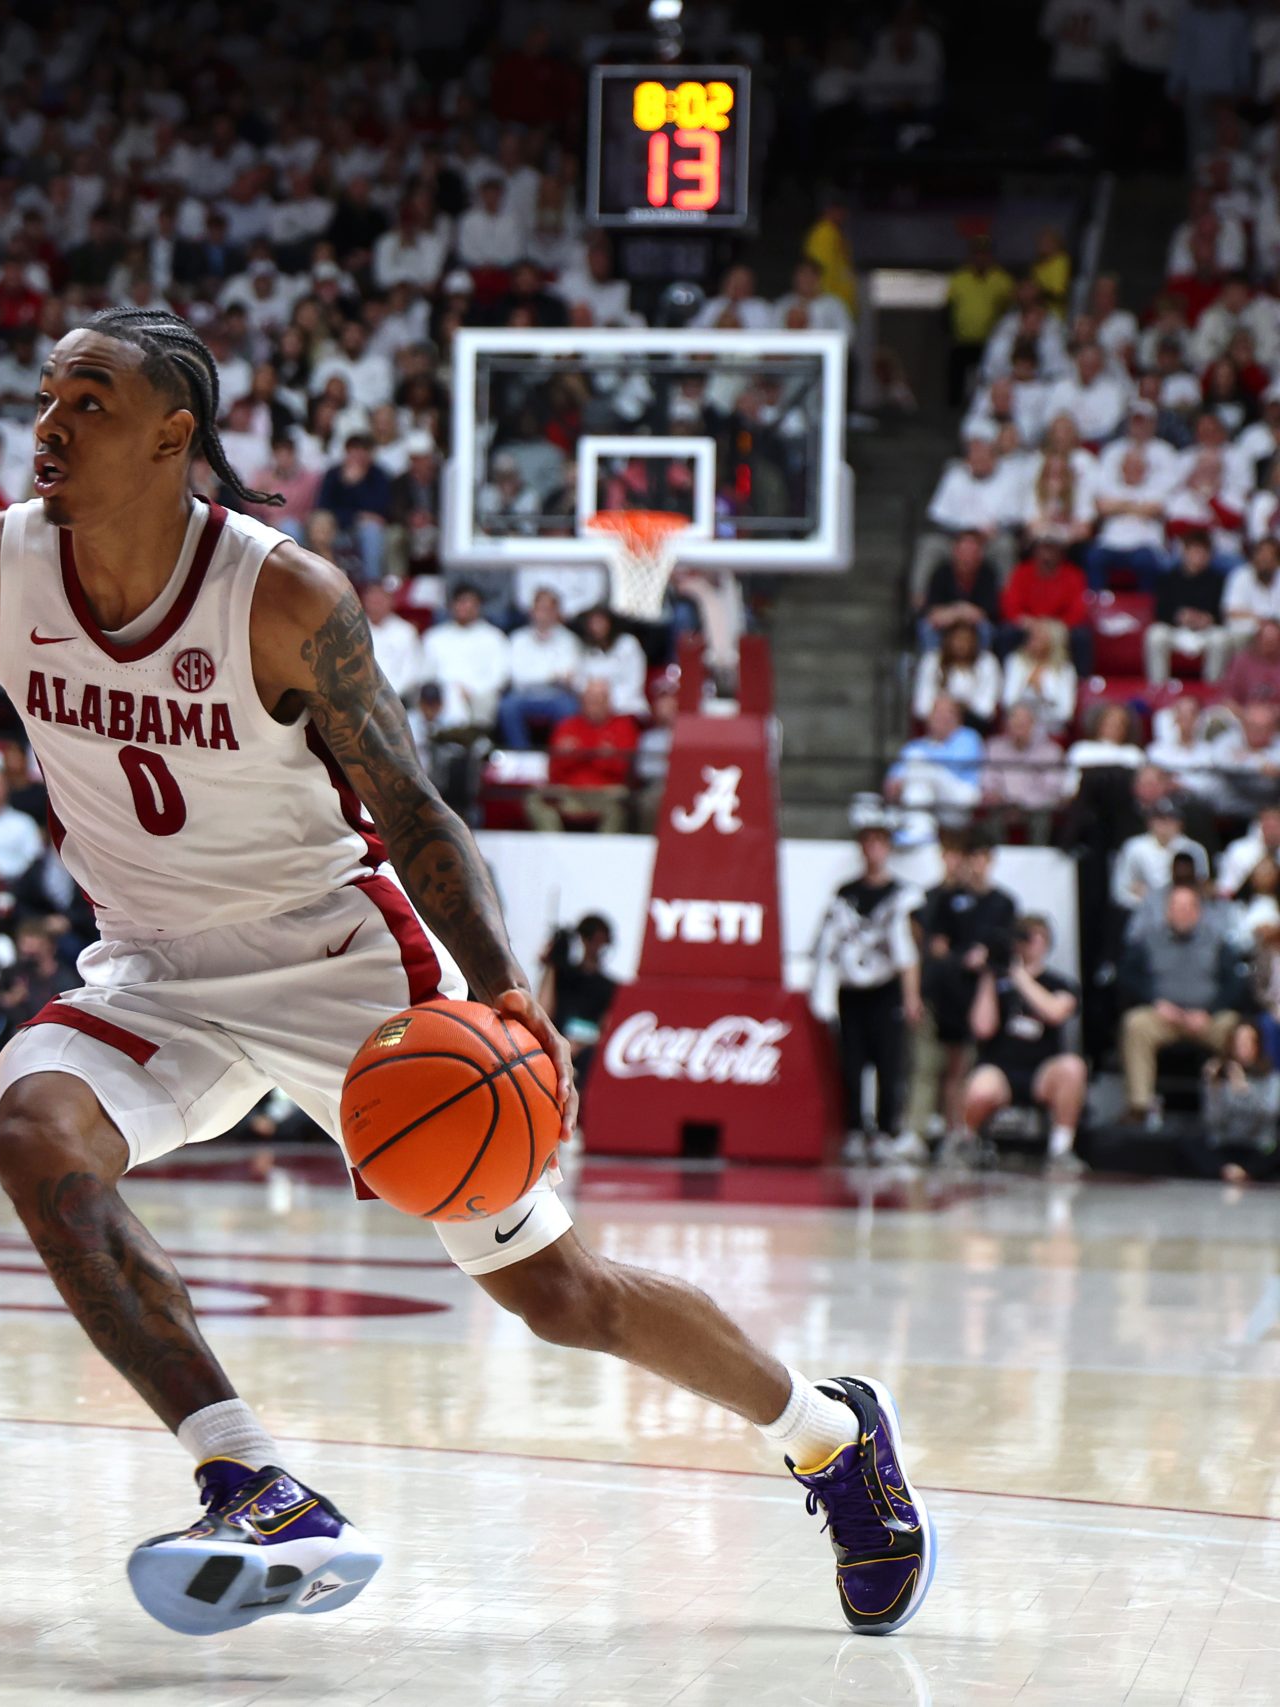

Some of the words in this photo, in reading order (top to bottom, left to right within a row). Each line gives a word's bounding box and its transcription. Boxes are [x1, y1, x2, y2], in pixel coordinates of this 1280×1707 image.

[633, 81, 734, 131] 8:02
[647, 129, 720, 211] 13
[174, 651, 215, 692] SEC
[26, 670, 240, 751] ALABAMA
[118, 744, 186, 836] 0
[671, 766, 742, 833] A
[650, 899, 763, 944] YETI
